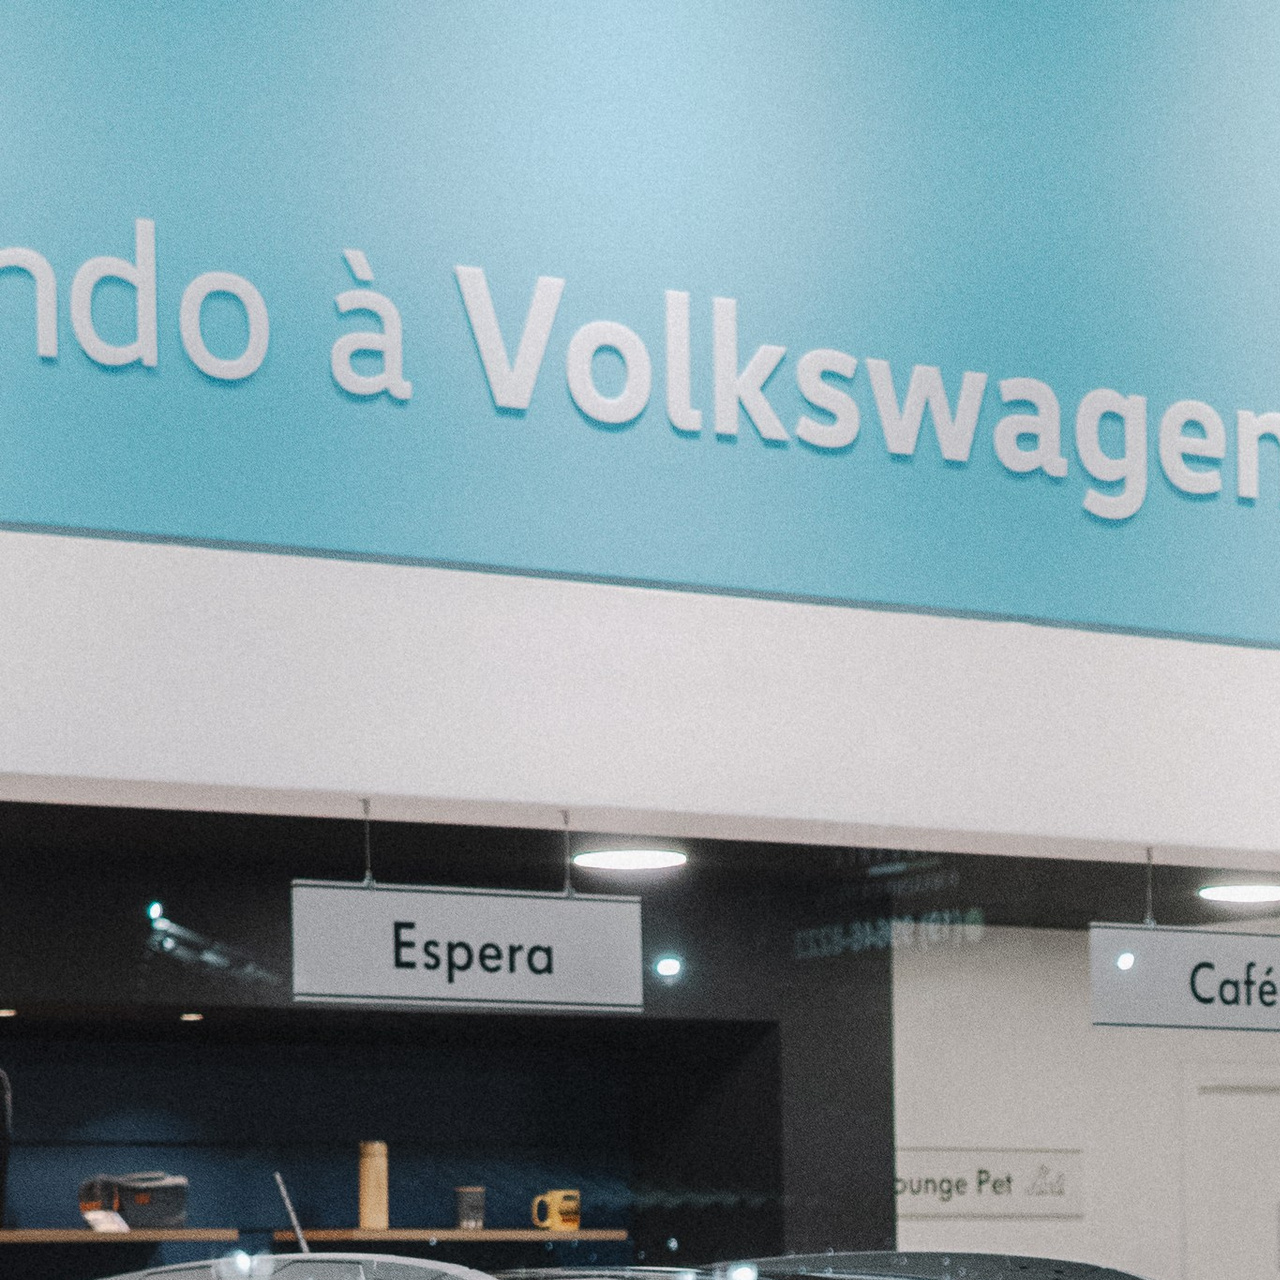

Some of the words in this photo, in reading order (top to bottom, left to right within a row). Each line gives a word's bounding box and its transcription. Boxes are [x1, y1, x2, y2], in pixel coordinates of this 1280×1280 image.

[0, 217, 270, 380] ndo
[330, 248, 412, 402] à
[394, 921, 553, 984] Espera
[1190, 961, 1278, 1007] Café
[977, 1168, 1012, 1195] Pet
